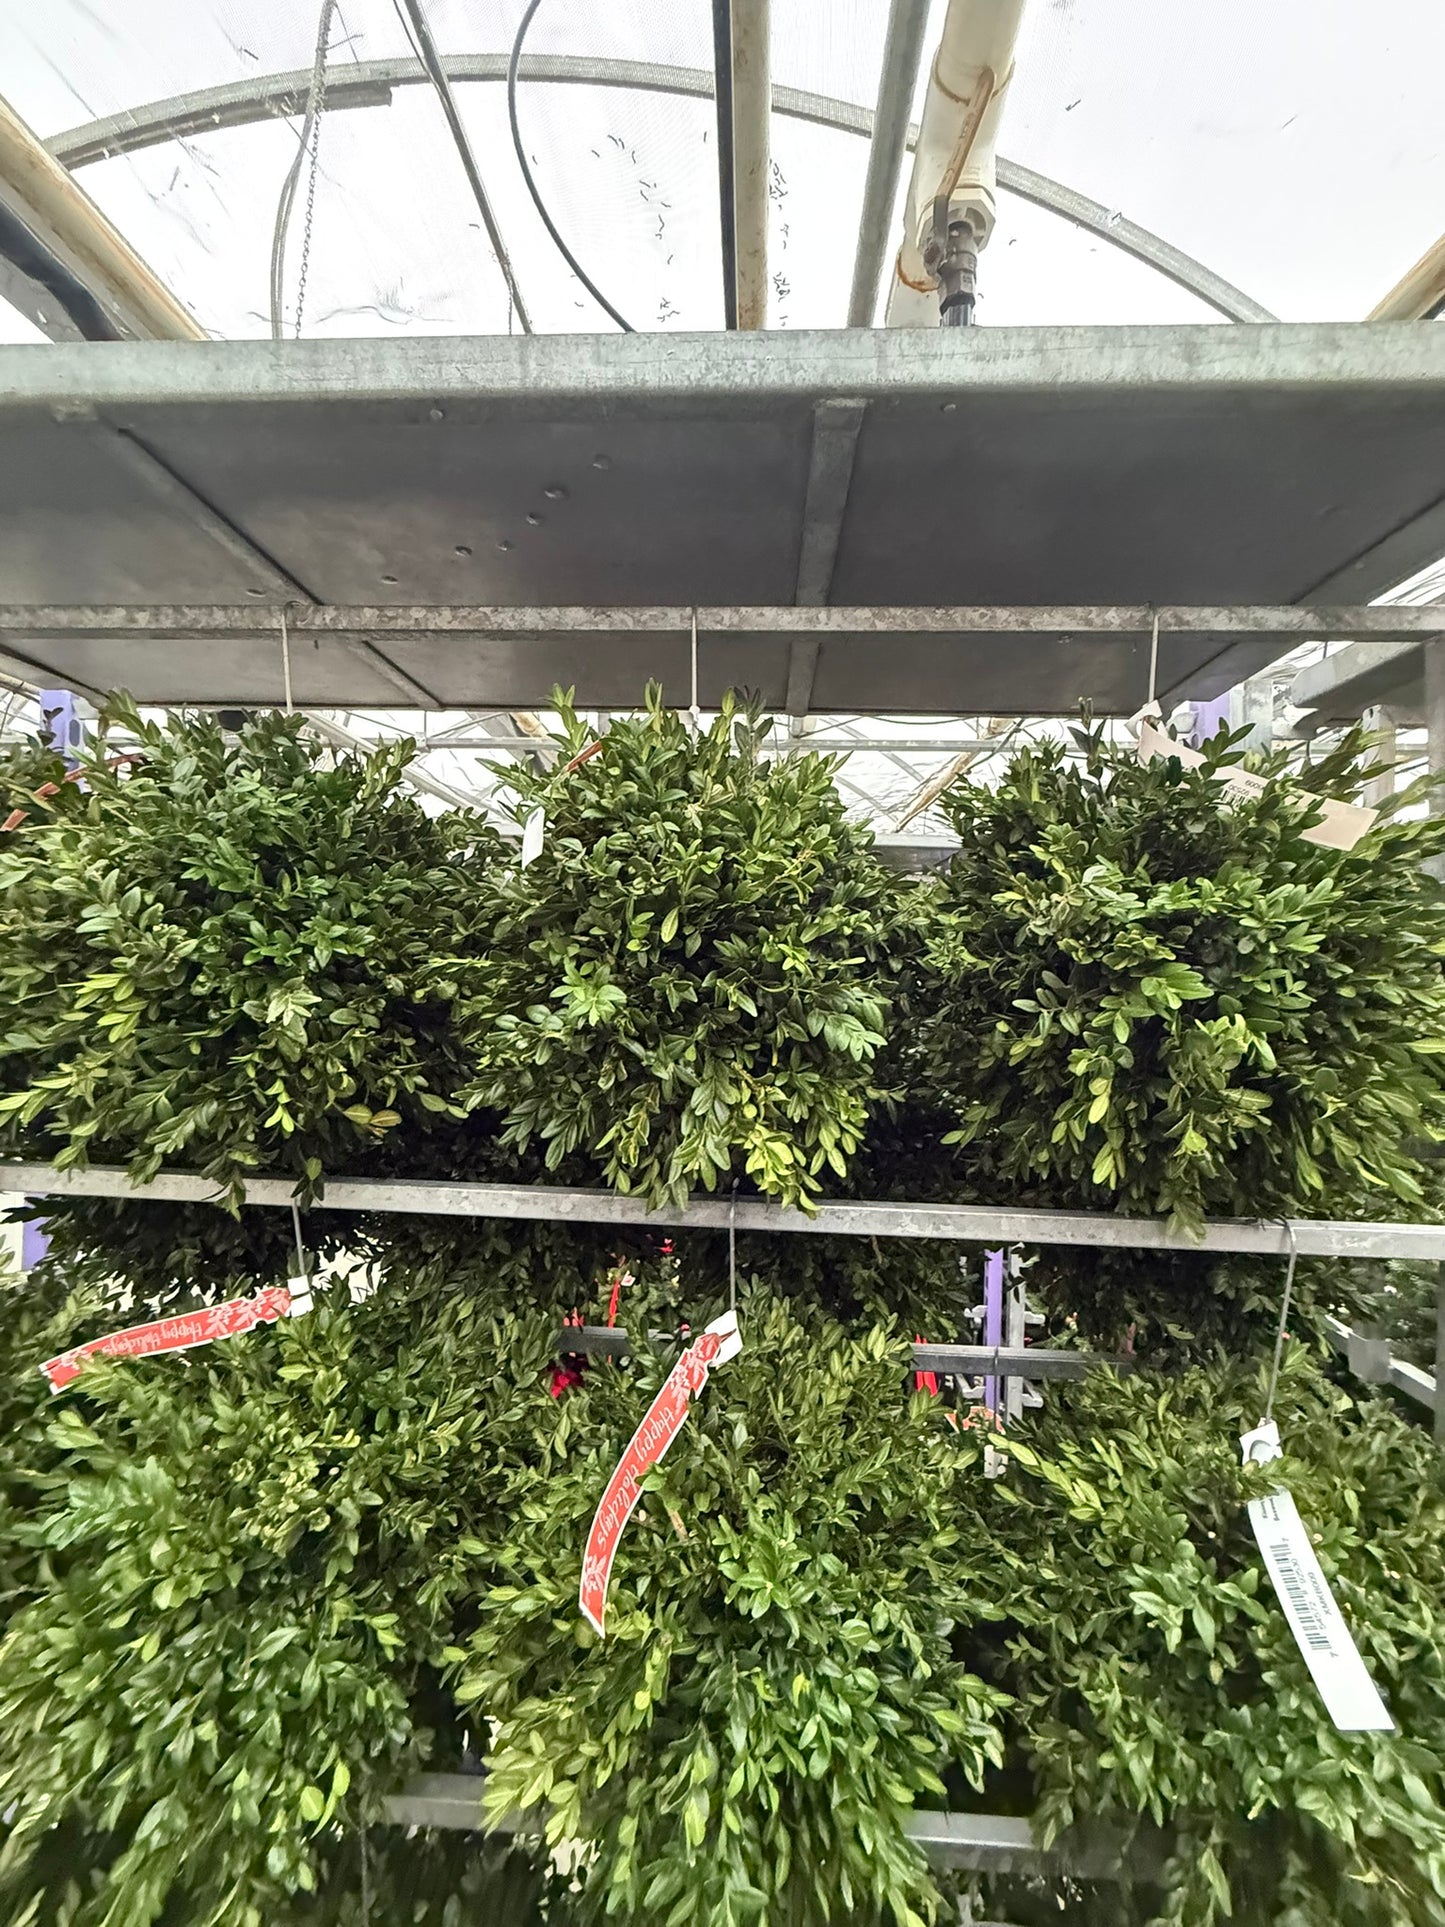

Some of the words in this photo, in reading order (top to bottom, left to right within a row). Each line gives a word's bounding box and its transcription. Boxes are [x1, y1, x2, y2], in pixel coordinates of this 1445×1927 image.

[102, 1332, 160, 1354] Holidays
[160, 1320, 203, 1343] Happy
[633, 1406, 675, 1463] Happy
[597, 1464, 640, 1552] Holidays
